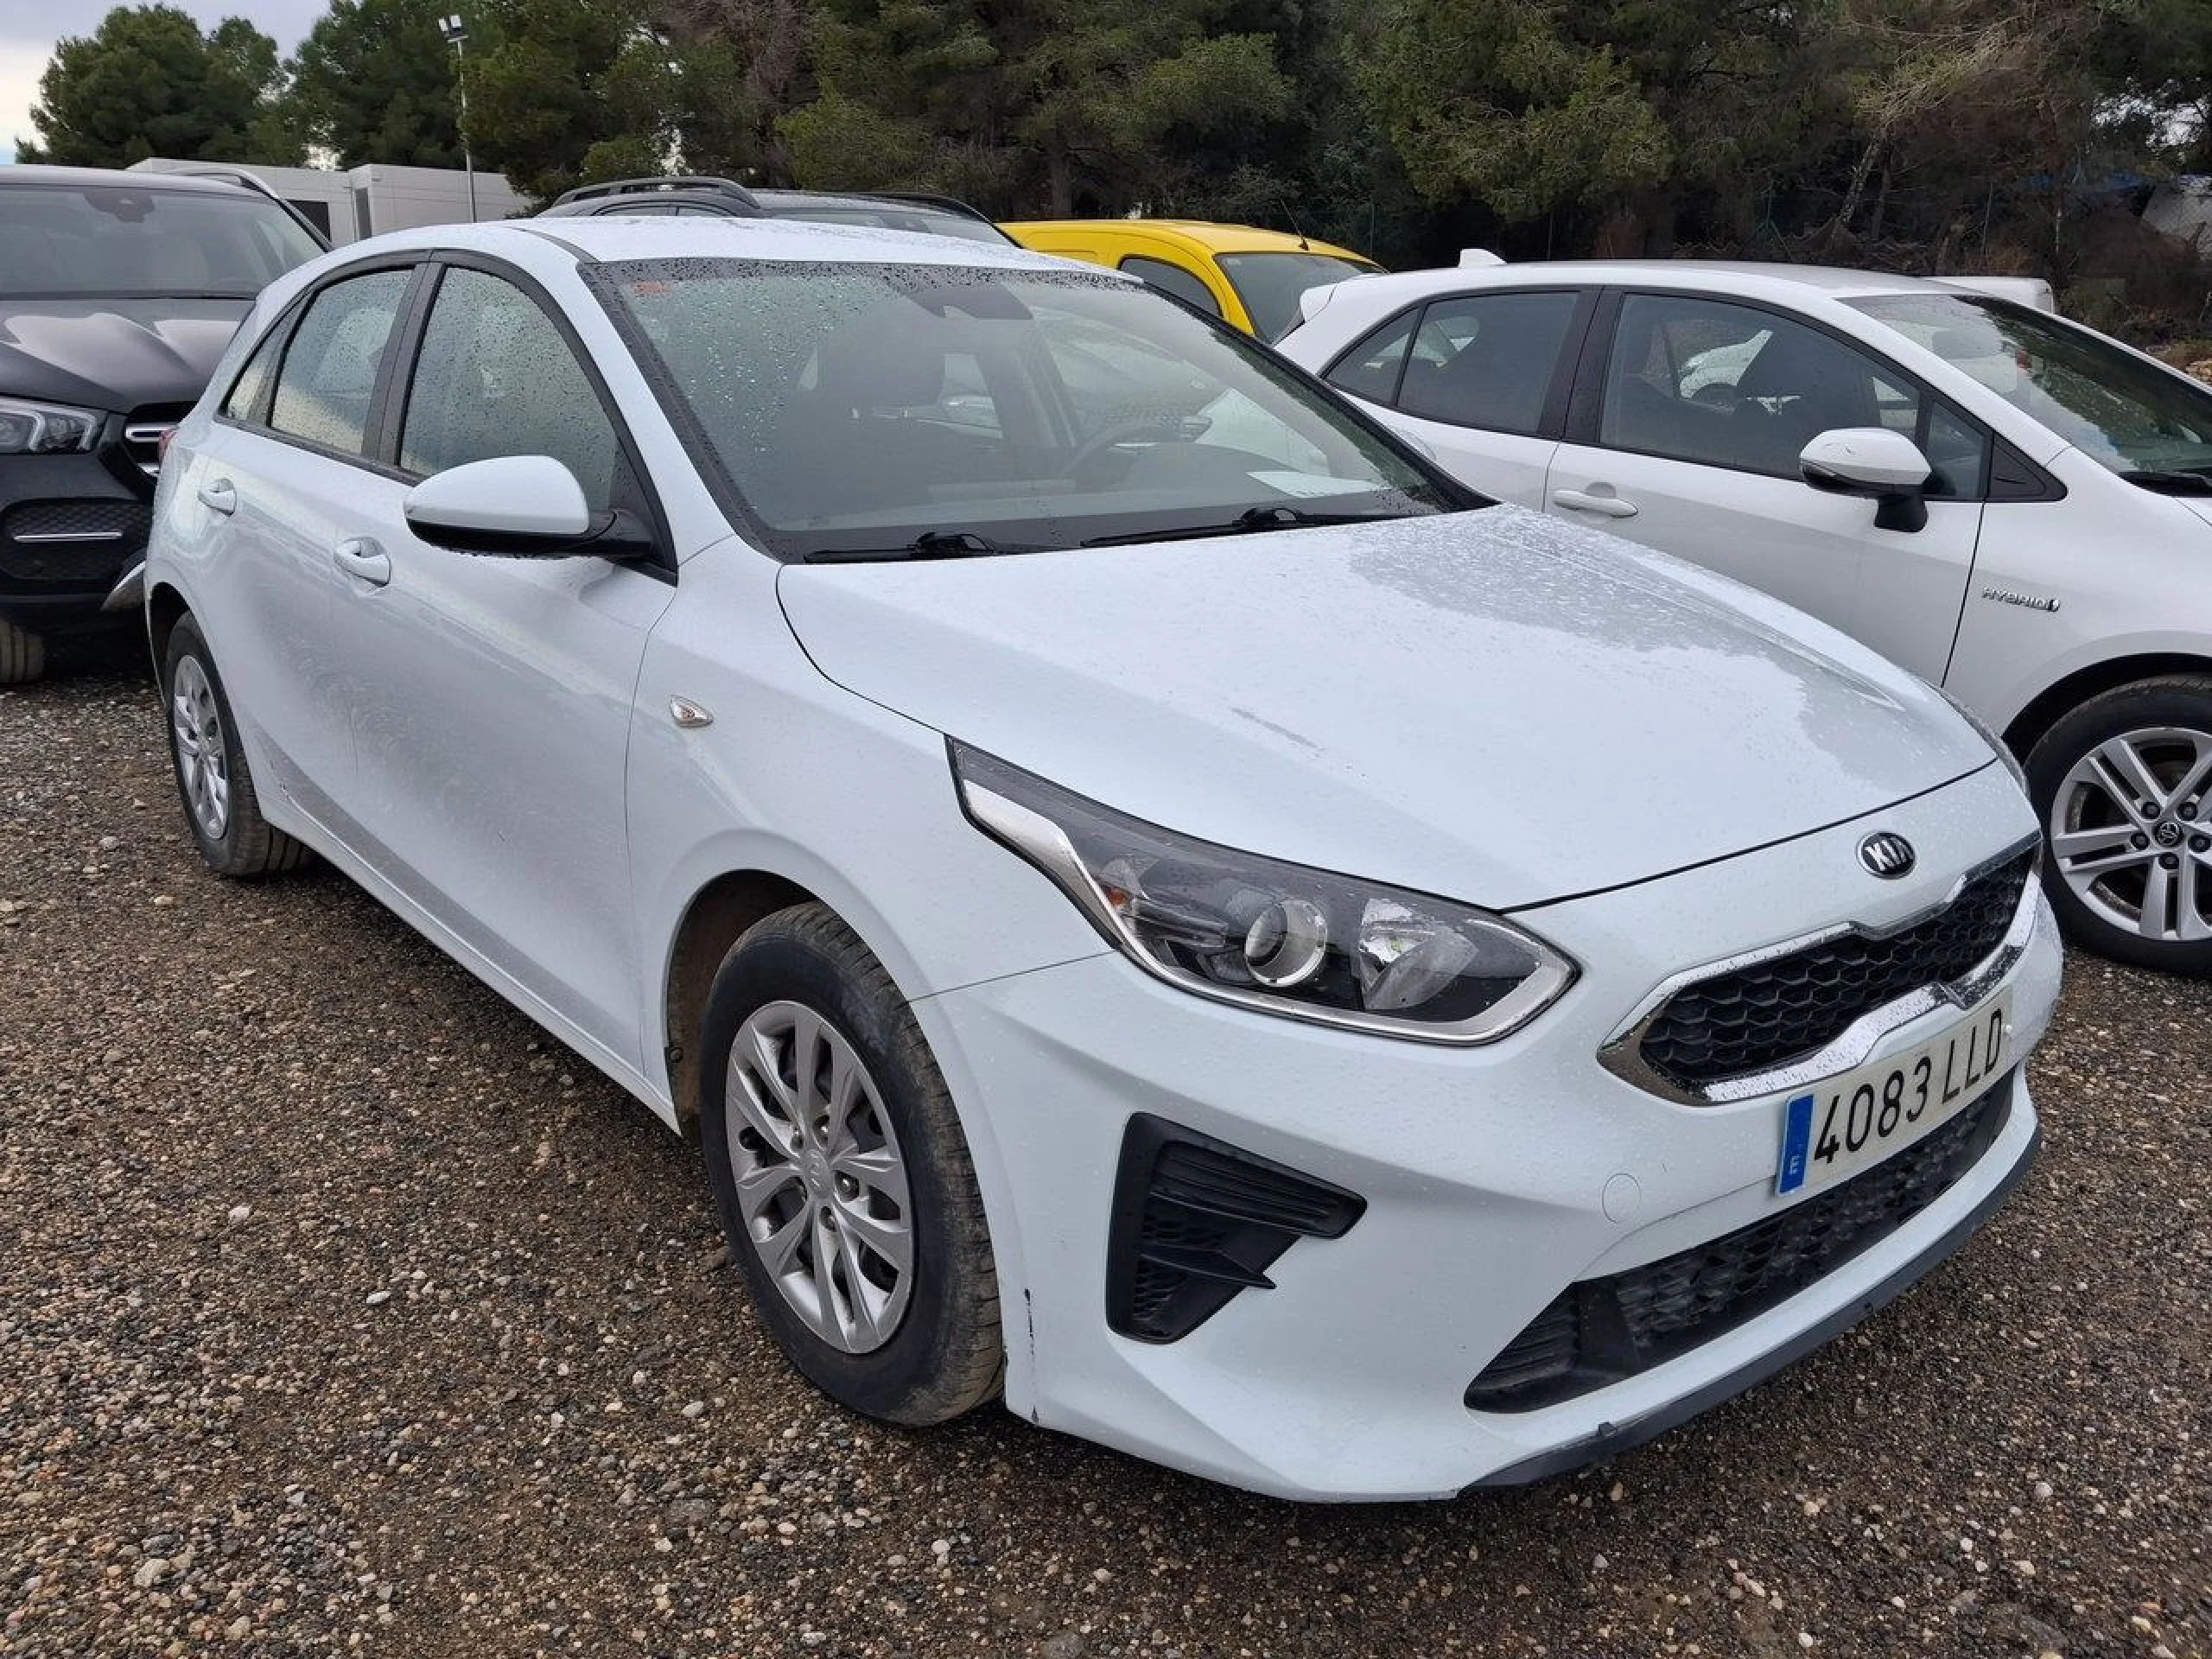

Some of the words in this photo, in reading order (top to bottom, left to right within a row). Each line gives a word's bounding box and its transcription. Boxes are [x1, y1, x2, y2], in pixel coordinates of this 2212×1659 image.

[1815, 1055, 1932, 1164] 4083
[1942, 1007, 2003, 1105] LLD
[1789, 1155, 1799, 1176] E
